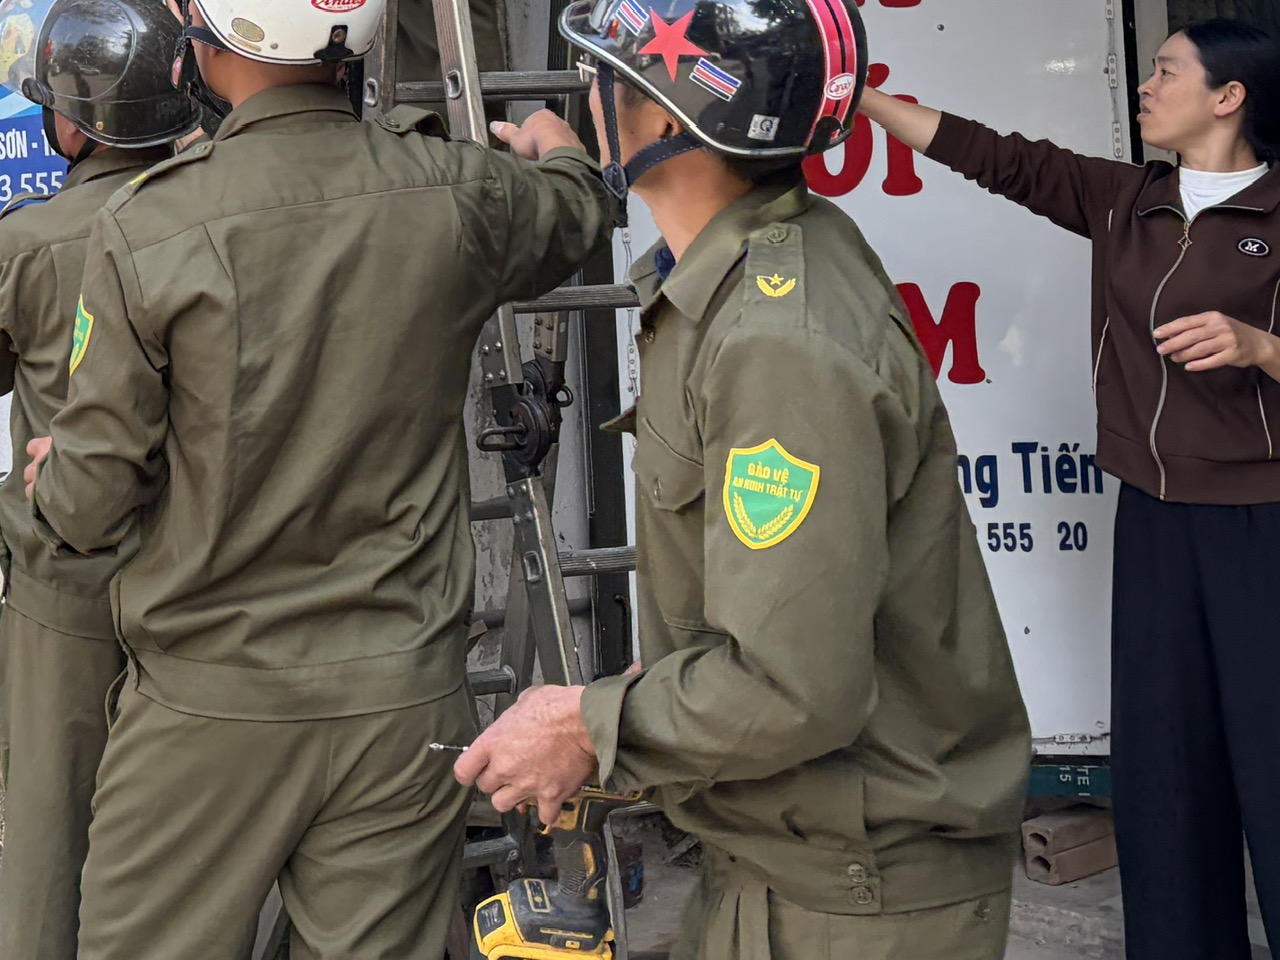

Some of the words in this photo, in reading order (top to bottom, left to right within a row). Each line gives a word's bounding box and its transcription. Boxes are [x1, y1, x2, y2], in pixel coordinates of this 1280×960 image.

[747, 461, 771, 479] BẢO
[773, 468, 790, 486] VỆ
[957, 454, 999, 508] ng
[1011, 441, 1104, 494] Tiến
[987, 522, 1034, 552] 555
[1057, 521, 1088, 551] 20
